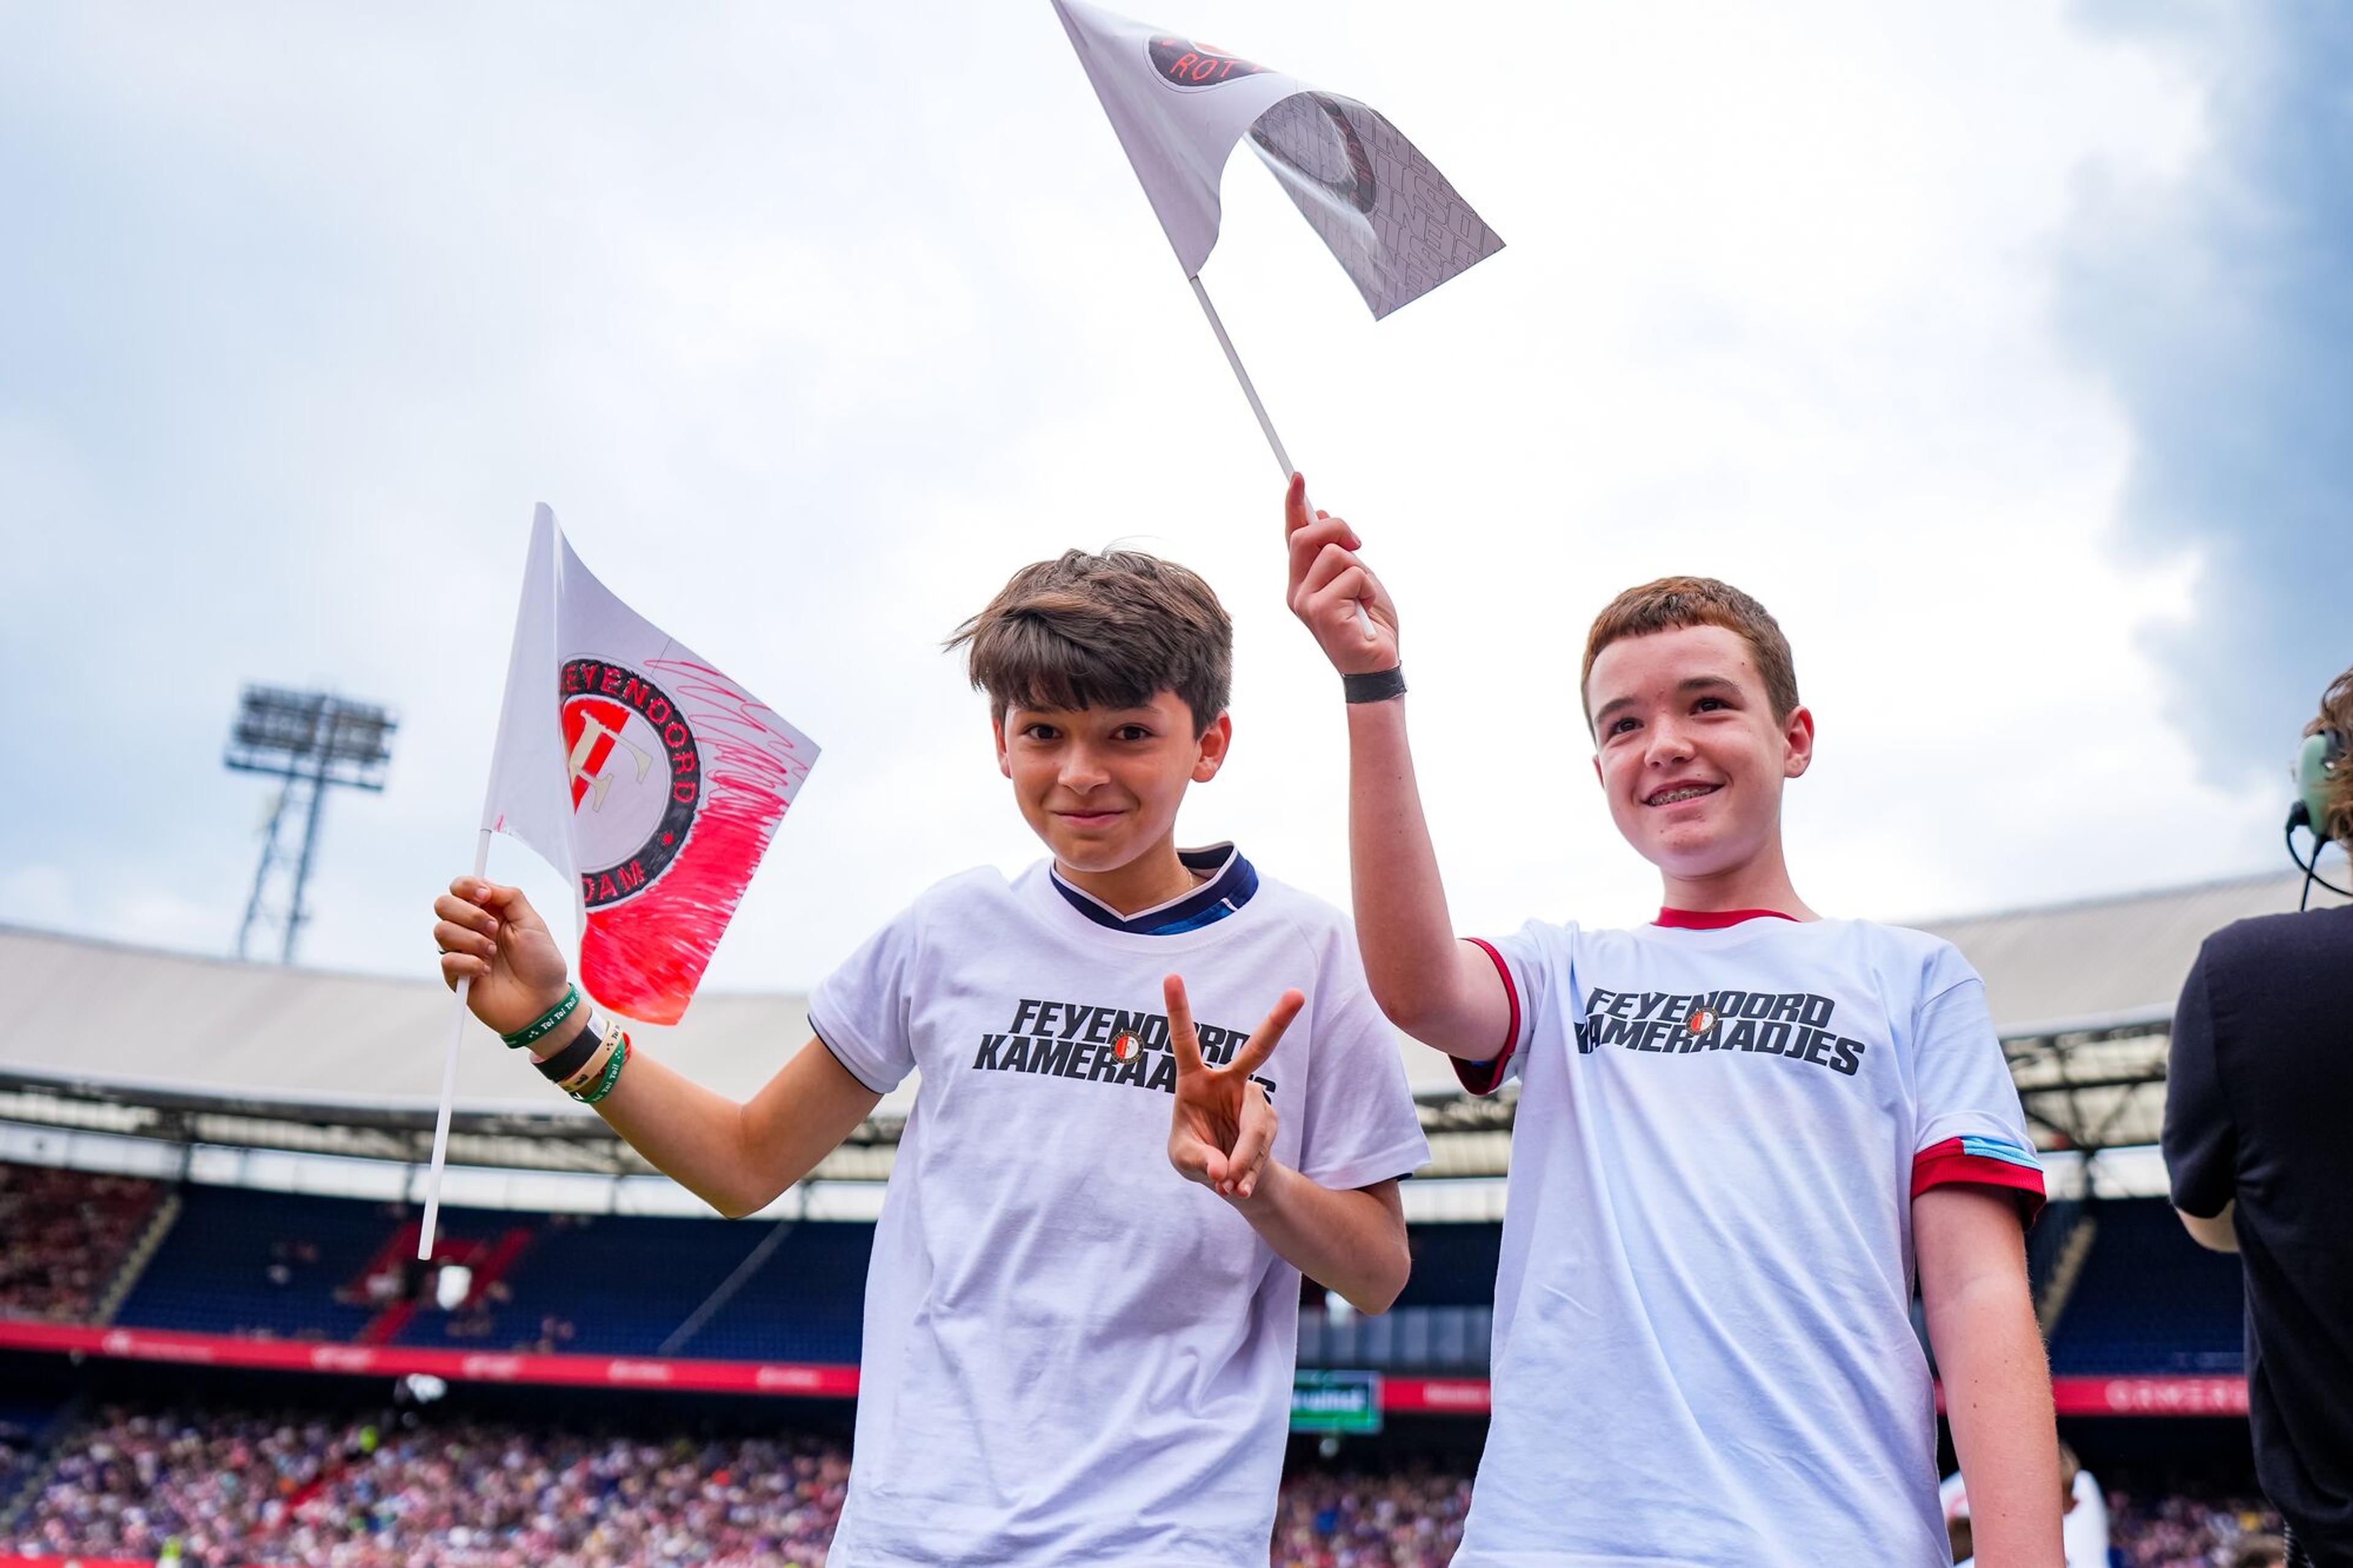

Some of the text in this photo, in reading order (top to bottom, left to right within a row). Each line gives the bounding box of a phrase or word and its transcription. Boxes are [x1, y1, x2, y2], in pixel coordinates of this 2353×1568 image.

[561, 664, 697, 803] EYENOORD
[1008, 998, 1251, 1064] FEYENORD
[1585, 987, 1836, 1029] FEYENOORD
